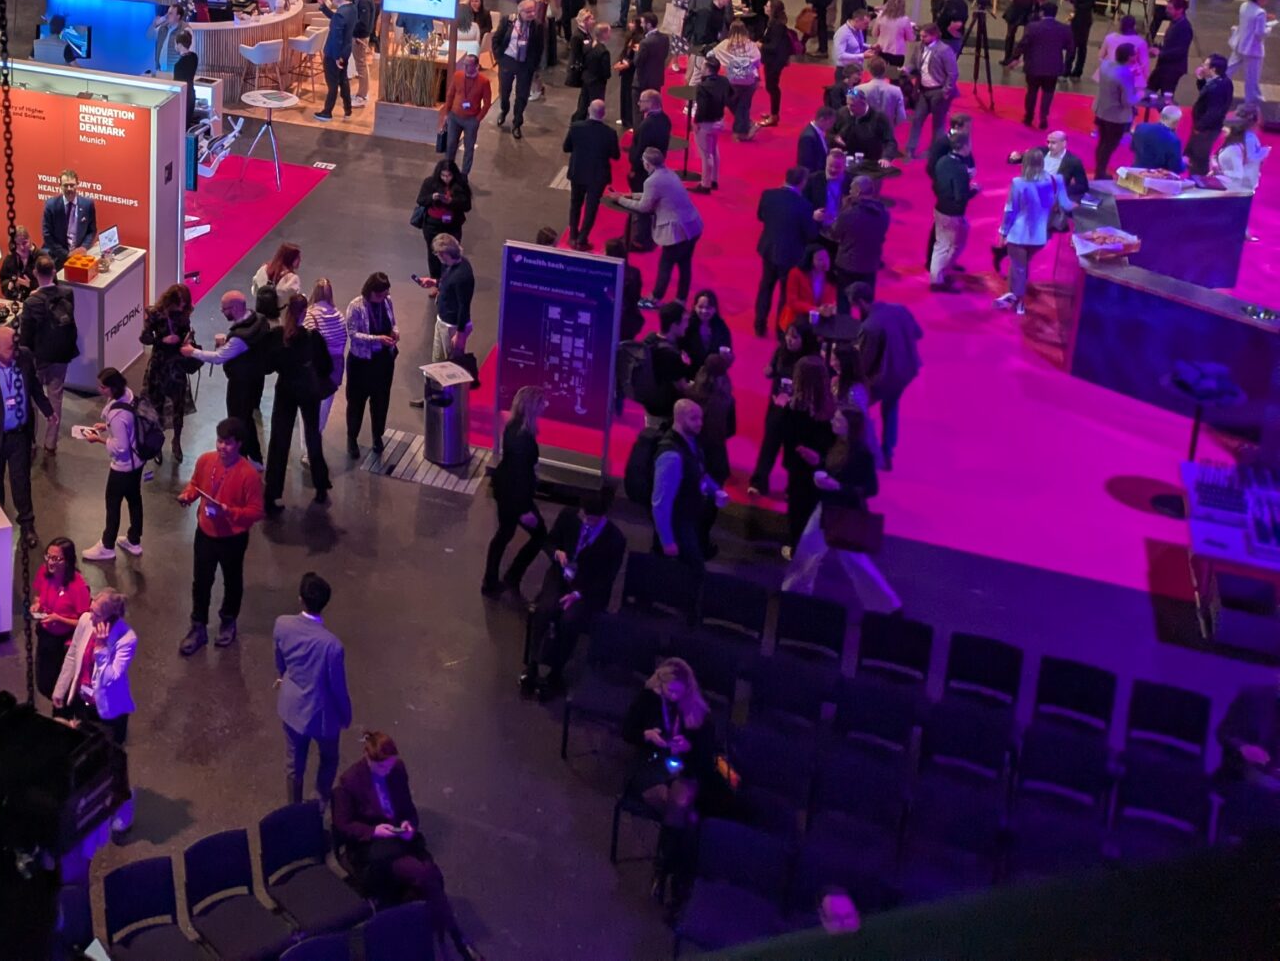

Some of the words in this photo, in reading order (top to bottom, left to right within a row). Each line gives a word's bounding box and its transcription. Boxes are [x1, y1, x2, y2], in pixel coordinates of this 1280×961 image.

[79, 104, 135, 120] INNOVATION
[79, 114, 114, 126] CENTRE
[79, 122, 126, 137] DENMARK
[79, 135, 106, 146] Munich
[38, 174, 57, 183] YOUR
[85, 192, 138, 206] PARTNERSHIPS
[551, 286, 574, 296] AROUND
